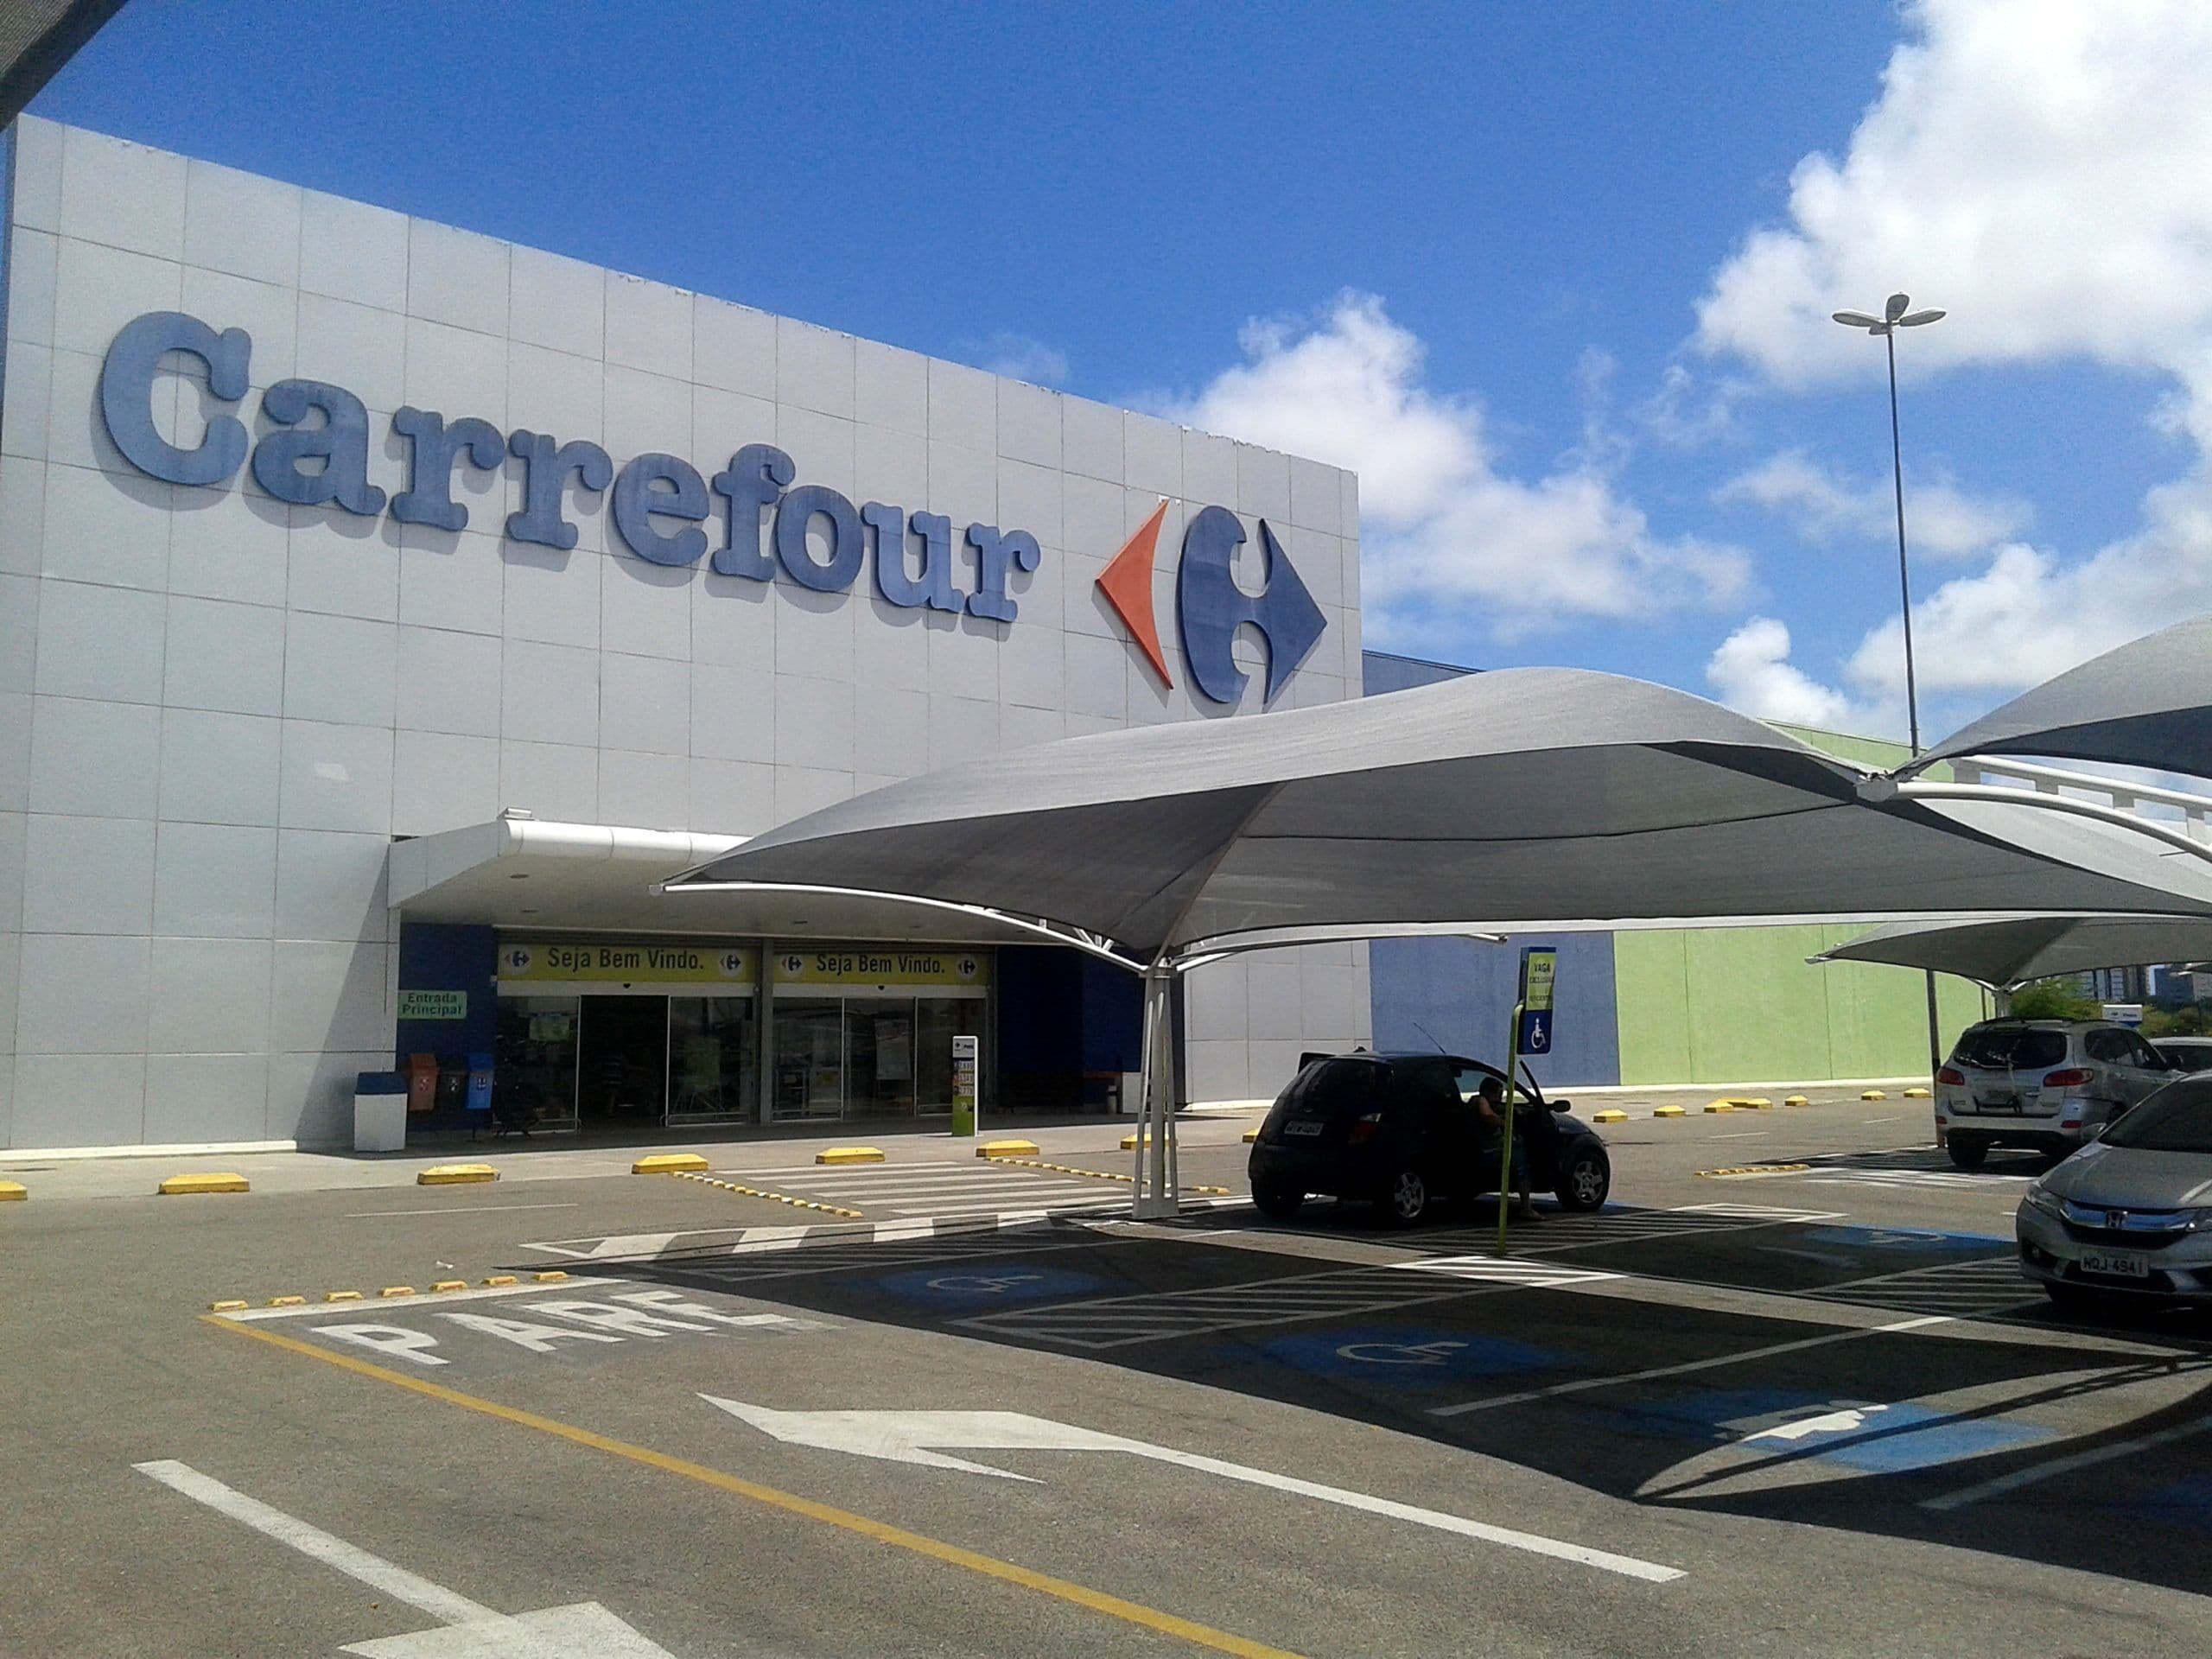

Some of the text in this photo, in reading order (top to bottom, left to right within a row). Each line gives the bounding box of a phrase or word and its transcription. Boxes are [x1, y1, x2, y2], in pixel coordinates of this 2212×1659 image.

[101, 311, 1040, 622] Carrefour
[547, 948, 704, 972] Seja Bem Vindo.
[816, 953, 945, 976] Seja Bem Vindo.
[408, 993, 457, 1003] Entrada
[403, 1004, 461, 1016] Principal
[310, 1291, 796, 1365] PARE
